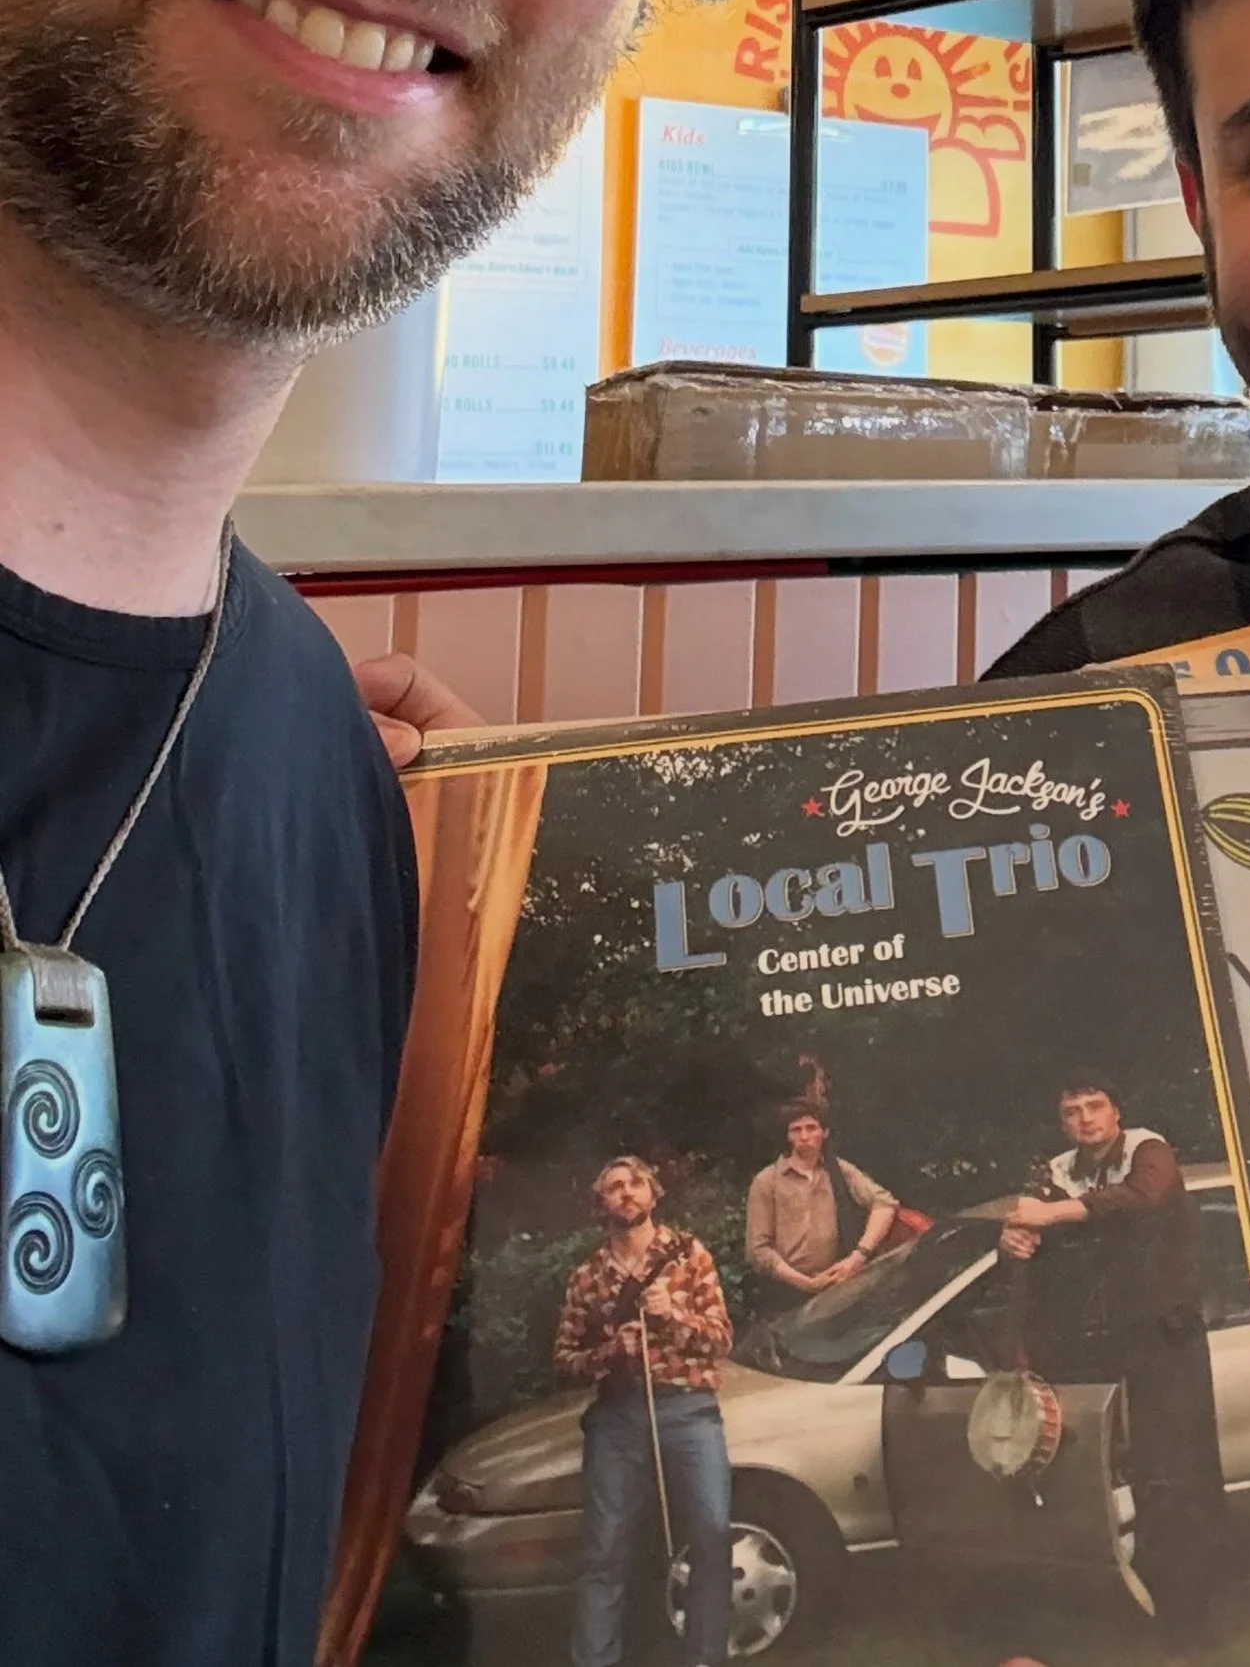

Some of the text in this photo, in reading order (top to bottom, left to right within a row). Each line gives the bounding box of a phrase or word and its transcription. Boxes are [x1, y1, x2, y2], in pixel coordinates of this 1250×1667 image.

[663, 125, 707, 146] Kids
[462, 354, 500, 369] ROLLS
[455, 396, 493, 412] ROLLS
[820, 757, 1110, 837] George Jackson's
[653, 823, 1112, 973] Local Trio
[757, 932, 905, 976] Center of
[759, 971, 962, 1018] the Universe
